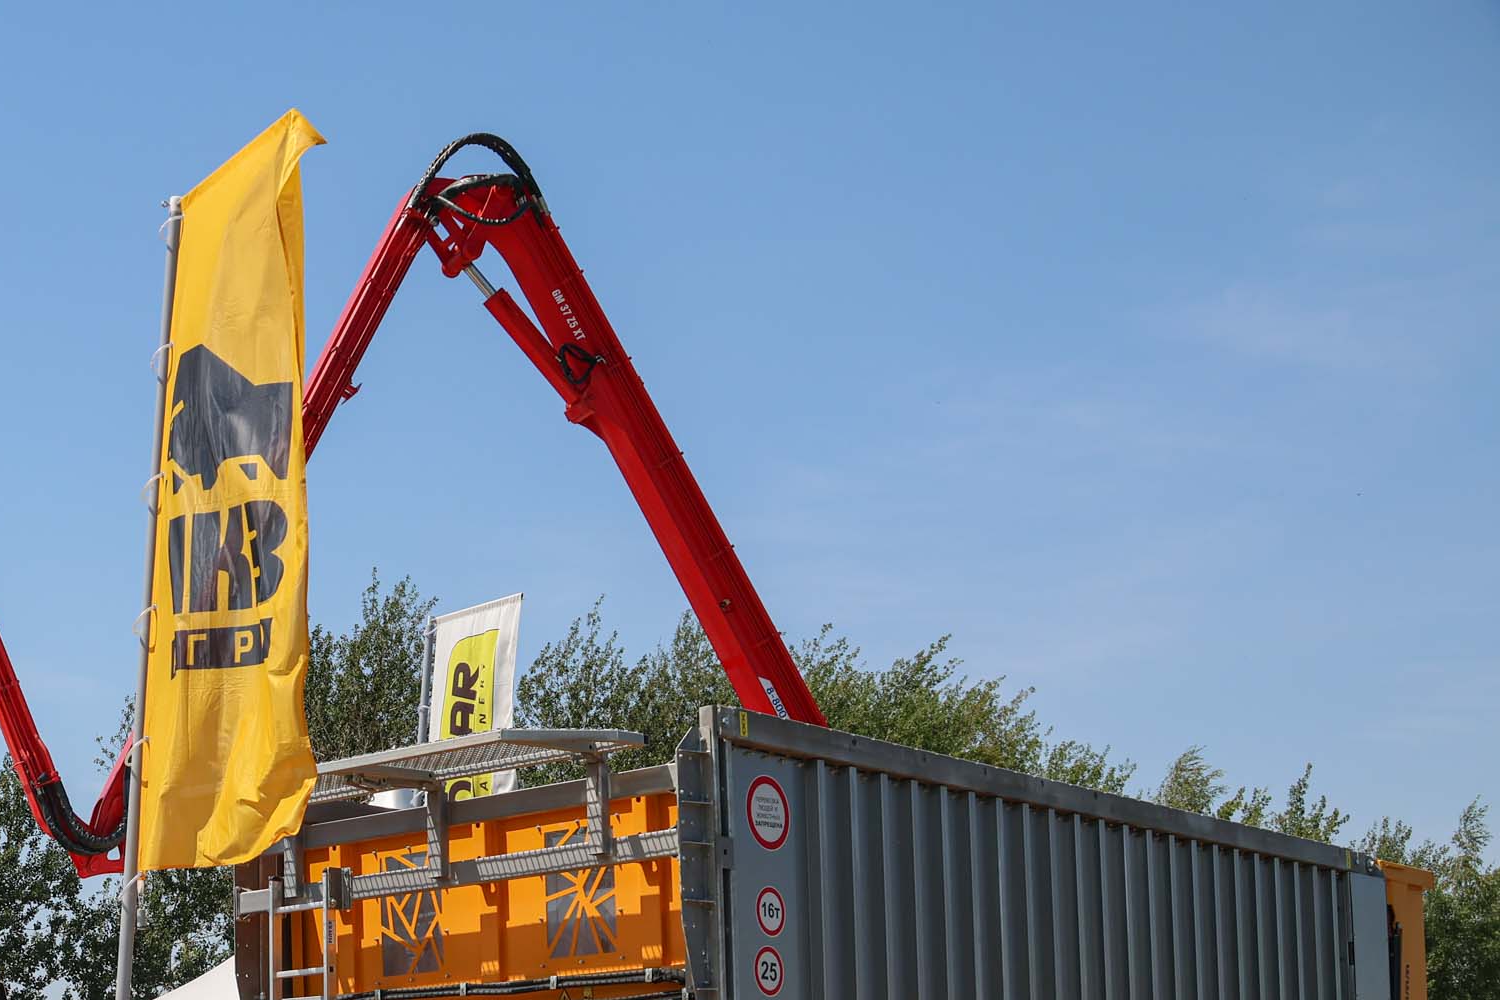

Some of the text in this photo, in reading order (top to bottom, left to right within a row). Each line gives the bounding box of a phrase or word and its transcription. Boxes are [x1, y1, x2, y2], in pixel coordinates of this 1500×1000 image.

[551, 288, 565, 305] GM
[560, 304, 572, 316] 37
[572, 327, 586, 341] XT
[766, 687, 787, 719] 8-800
[760, 961, 778, 982] 25
